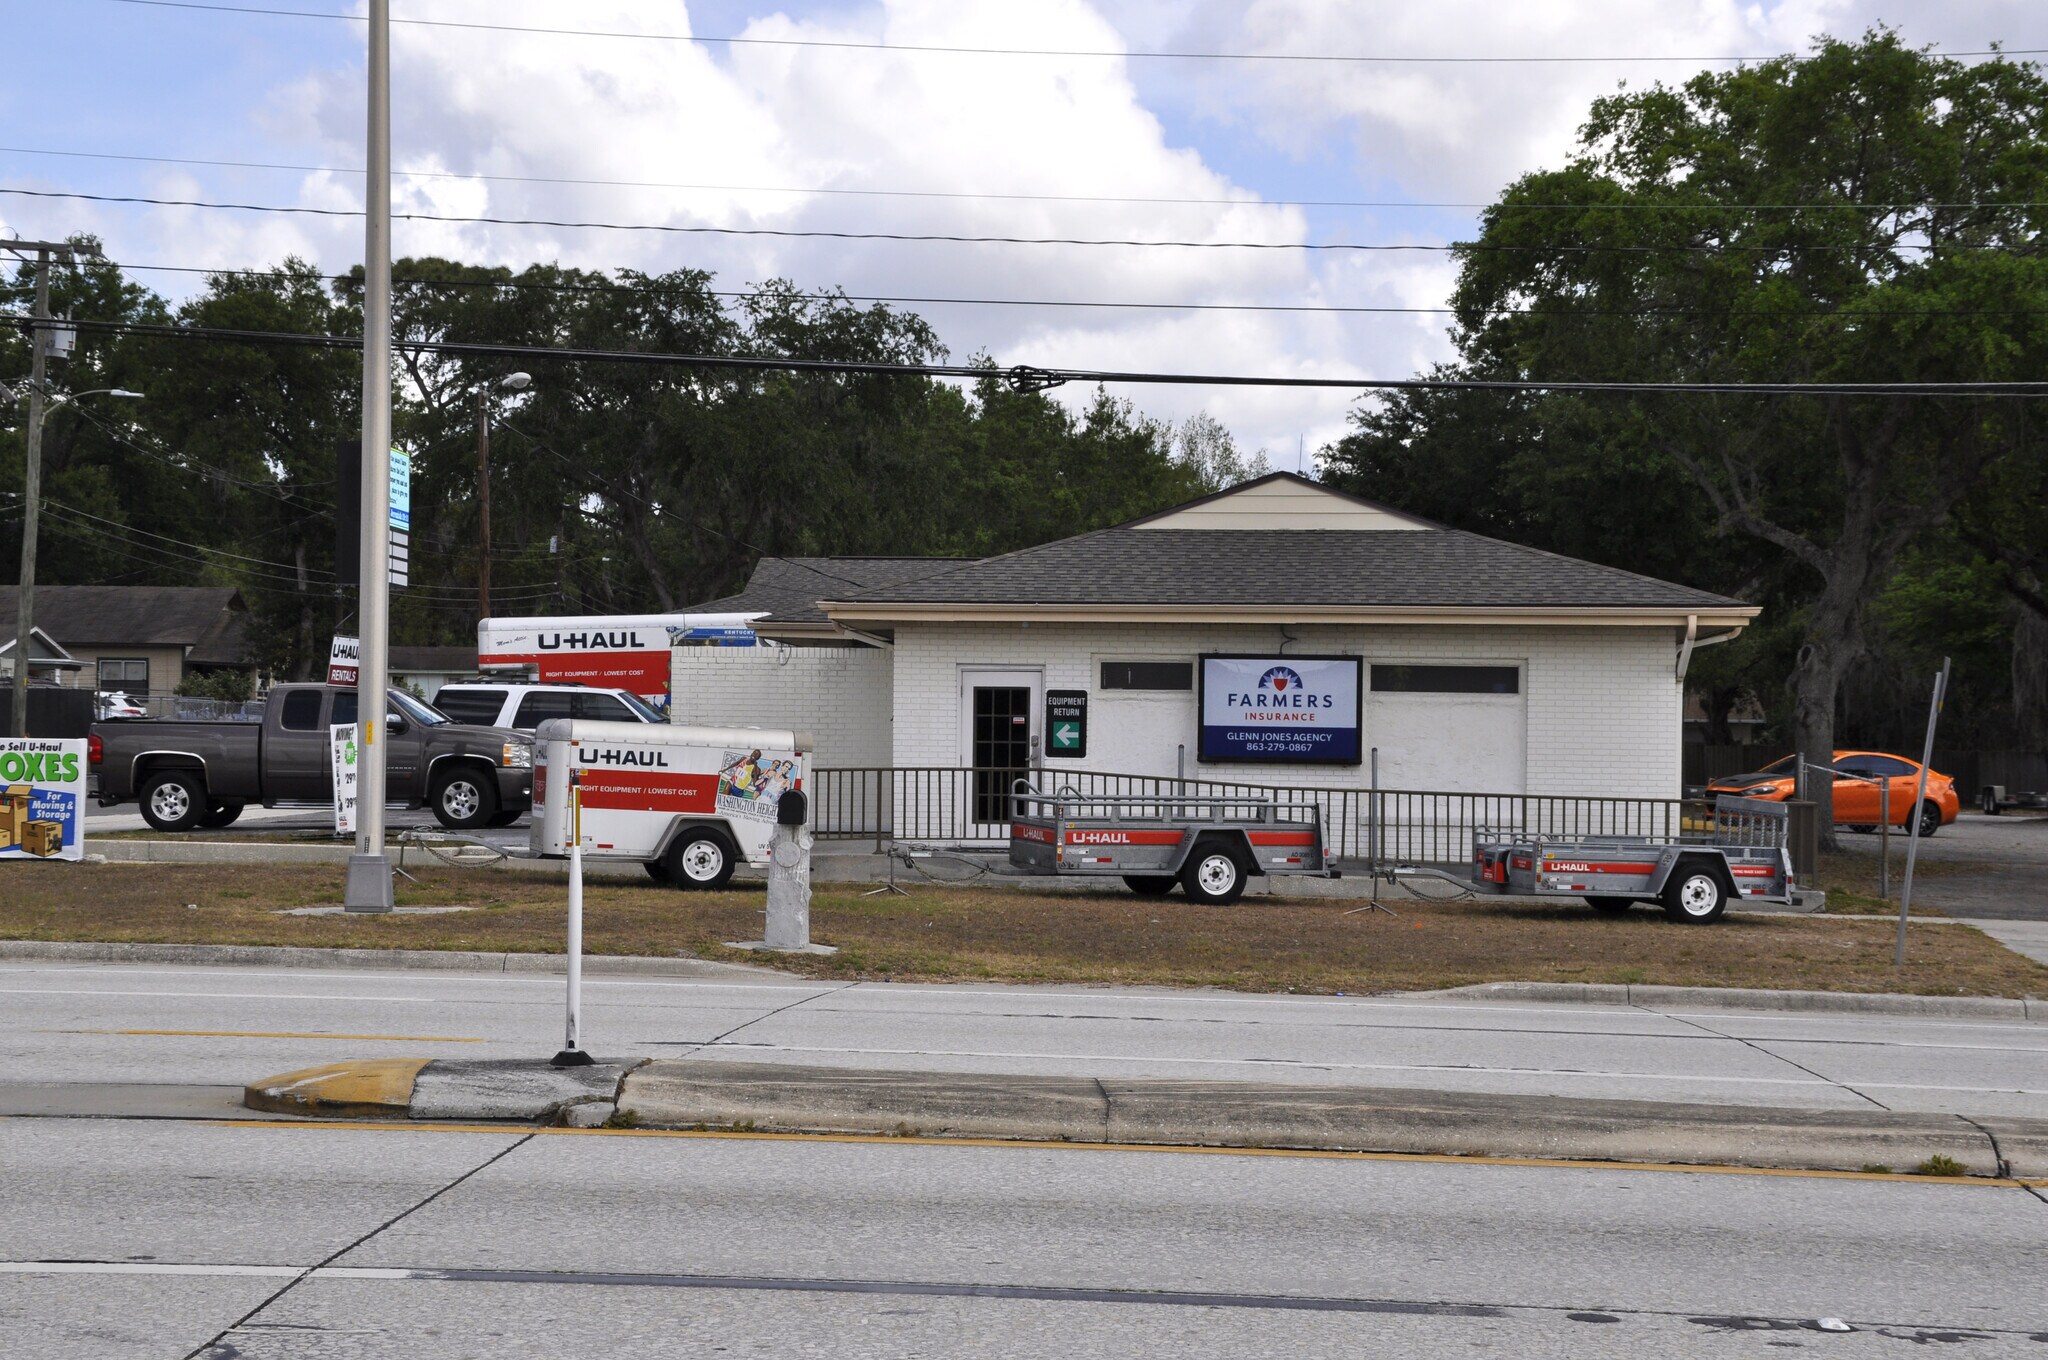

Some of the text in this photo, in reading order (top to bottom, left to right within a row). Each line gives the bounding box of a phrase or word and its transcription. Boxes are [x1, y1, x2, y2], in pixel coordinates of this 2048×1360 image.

[538, 632, 645, 649] U-HAUL
[332, 644, 360, 660] U-HAU
[331, 669, 357, 682] RENTALS
[1048, 697, 1086, 706] EQUIPMENT
[1228, 693, 1333, 708] FARMERS
[1053, 708, 1080, 716] RETURN
[1244, 712, 1316, 722] INSURANCE
[1227, 732, 1333, 742] GLENN JONES AGENCY
[8, 742, 26, 752] Sell
[29, 742, 62, 752] U-Haul
[1246, 743, 1313, 752] 863-279-0867
[579, 748, 669, 767] U-HAUL
[0, 752, 79, 782] OXES
[46, 791, 61, 800] For
[600, 785, 642, 794] EQUIPMENT
[648, 787, 677, 795] LOWEST
[678, 788, 697, 796] COST
[32, 800, 74, 812] Moving &
[717, 794, 757, 811] WASHINGTON
[757, 802, 778, 817] HEIGH
[36, 810, 71, 820] Storage
[1023, 828, 1044, 841] U-HAUL
[1072, 833, 1131, 843] U-HAUL
[1551, 863, 1591, 871] U-HAUL
